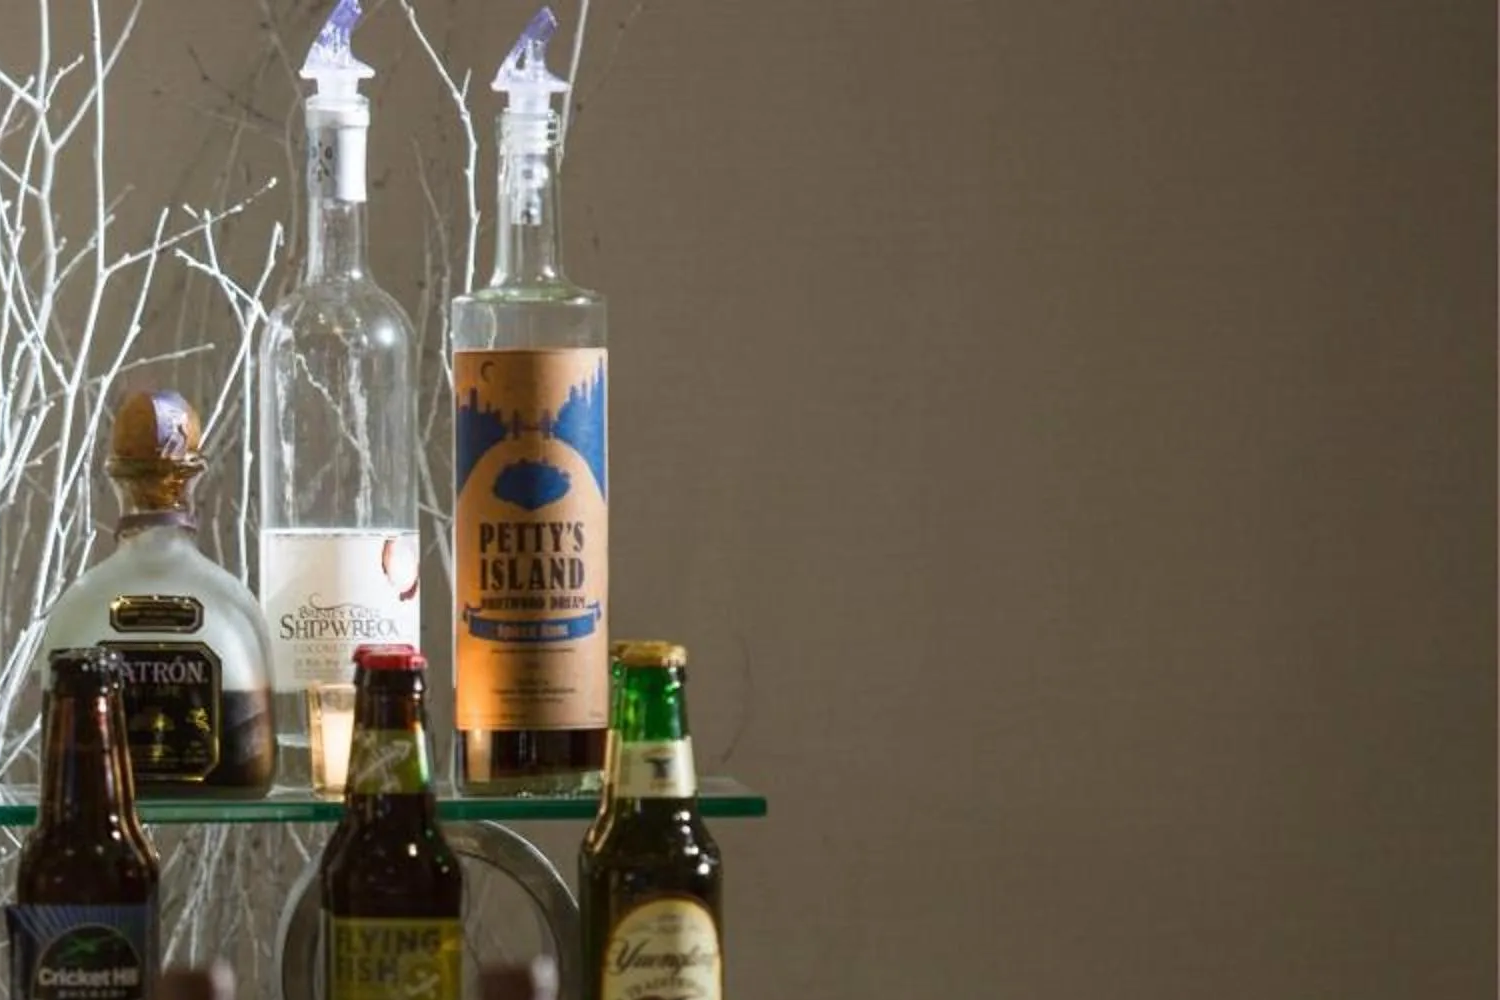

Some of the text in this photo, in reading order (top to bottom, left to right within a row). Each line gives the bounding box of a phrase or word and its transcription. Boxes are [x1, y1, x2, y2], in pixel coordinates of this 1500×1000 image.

[479, 521, 585, 553] PETTY'S
[479, 556, 585, 591] ISLAND
[119, 654, 203, 684] ATRÓN
